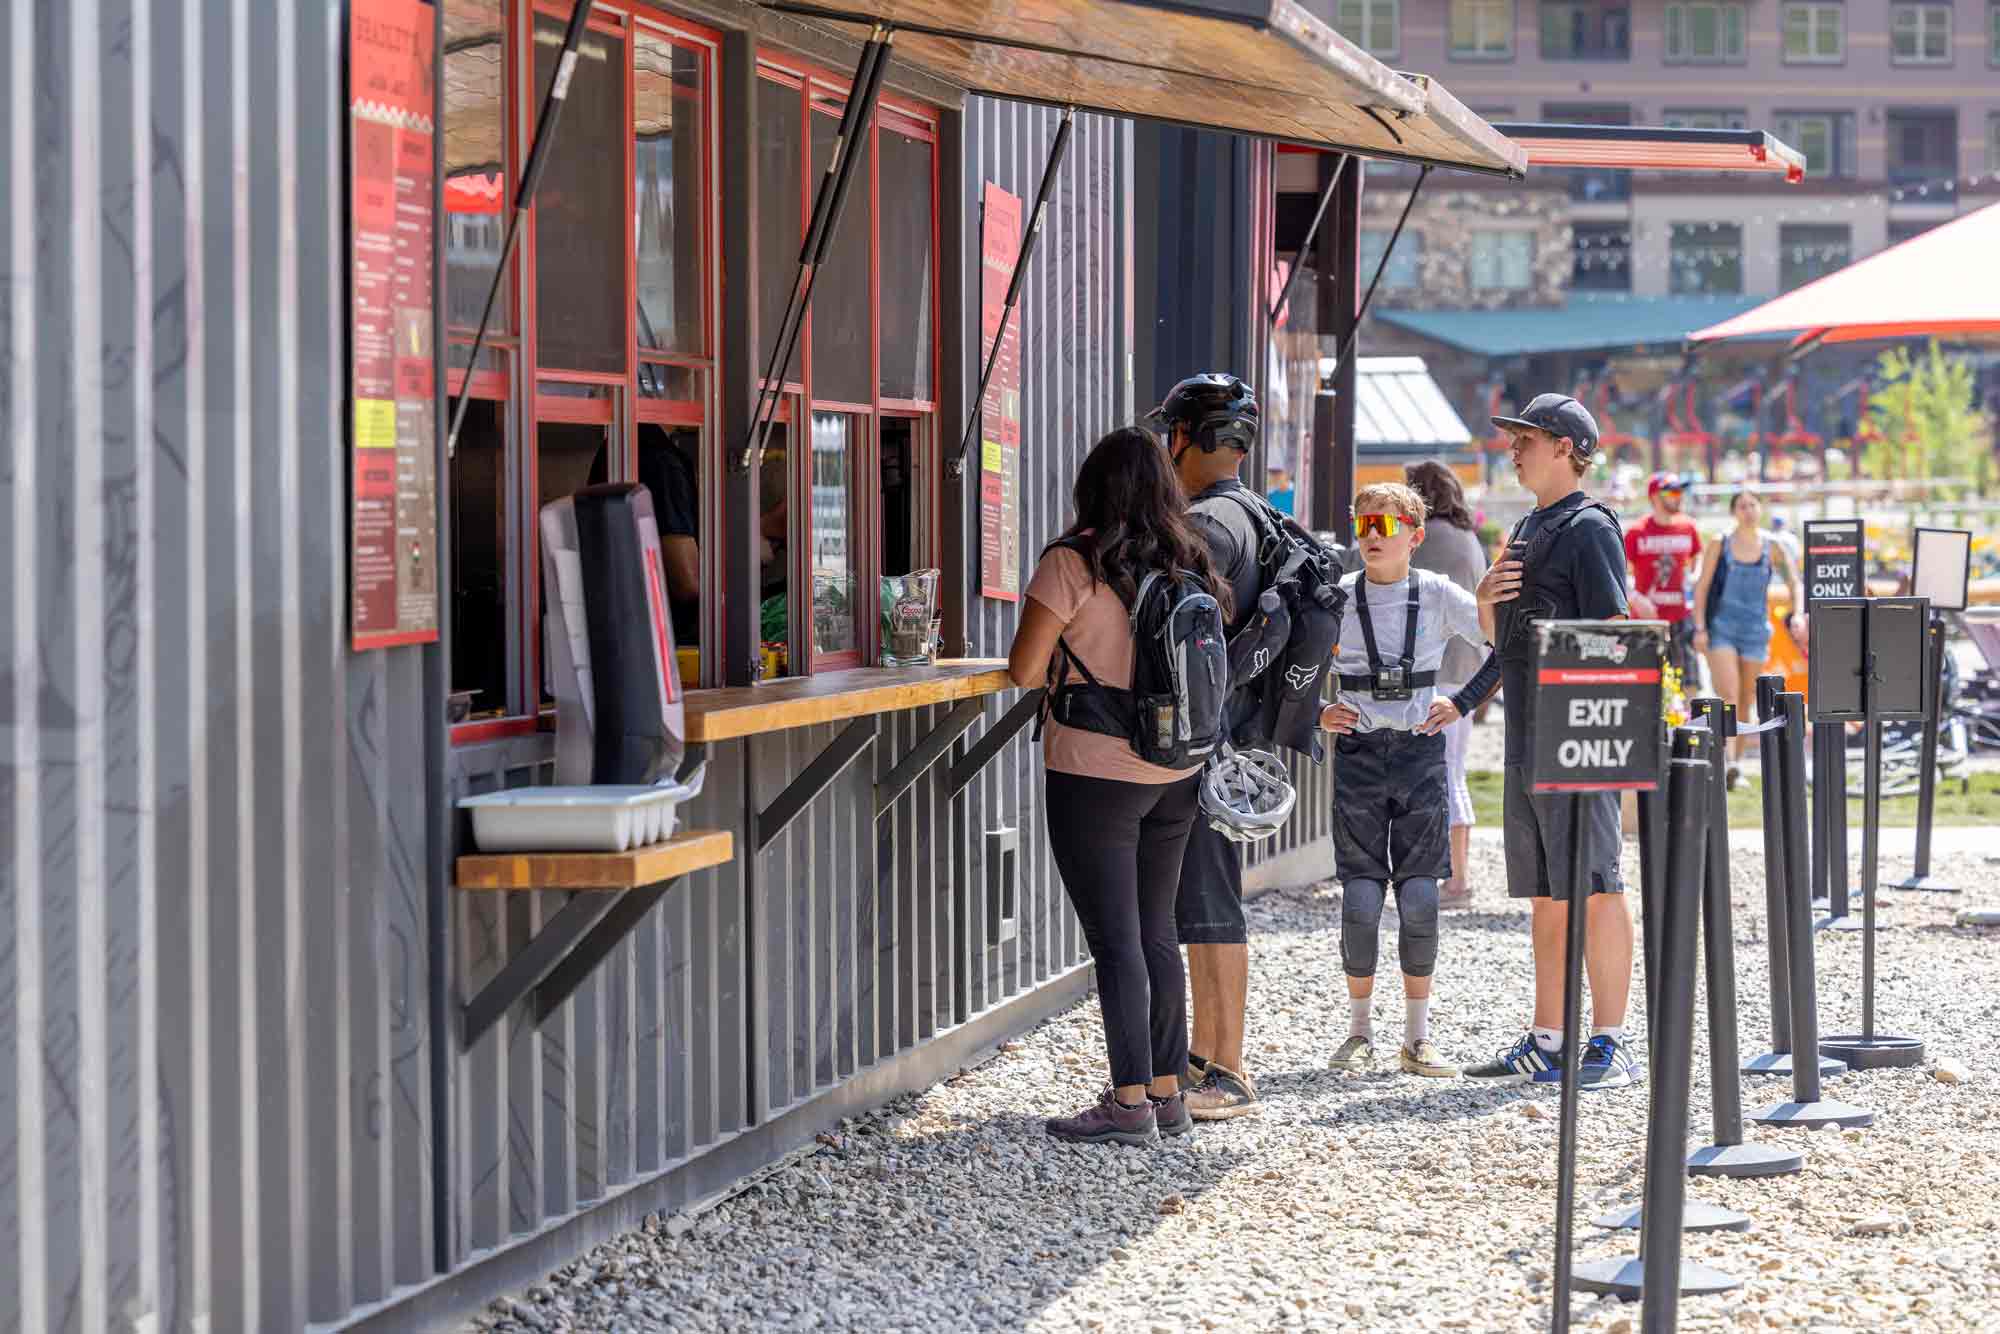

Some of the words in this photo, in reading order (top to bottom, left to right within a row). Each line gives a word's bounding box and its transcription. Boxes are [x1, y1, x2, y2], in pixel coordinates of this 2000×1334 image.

[1817, 564, 1850, 578] EXIT
[1813, 583, 1854, 597] ONLY
[1568, 698, 1628, 727] EXIT
[1557, 739, 1633, 769] ONLY
